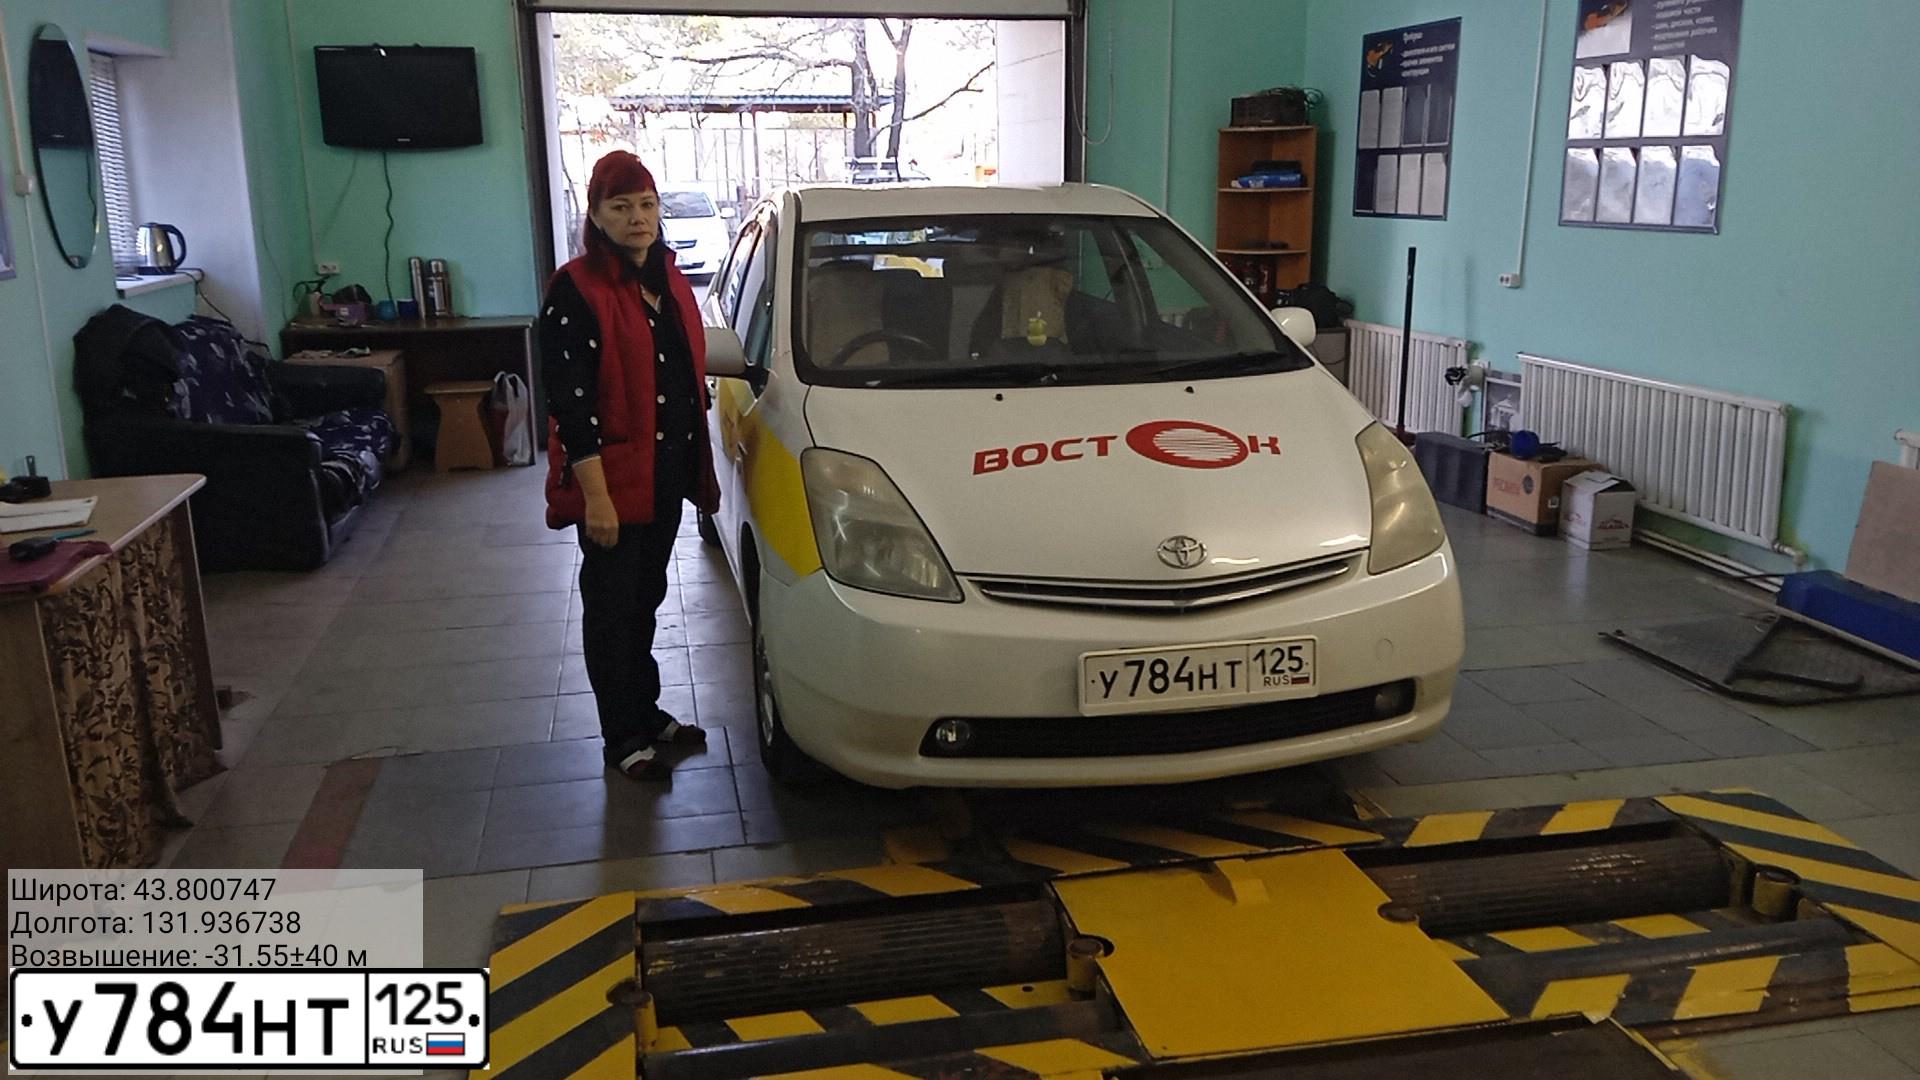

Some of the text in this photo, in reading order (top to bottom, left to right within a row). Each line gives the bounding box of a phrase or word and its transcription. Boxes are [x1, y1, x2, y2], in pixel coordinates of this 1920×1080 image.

[972, 420, 1281, 475] ВОСТОК
[1099, 646, 1303, 699] У784НТ 125
[1263, 675, 1290, 686] RUS
